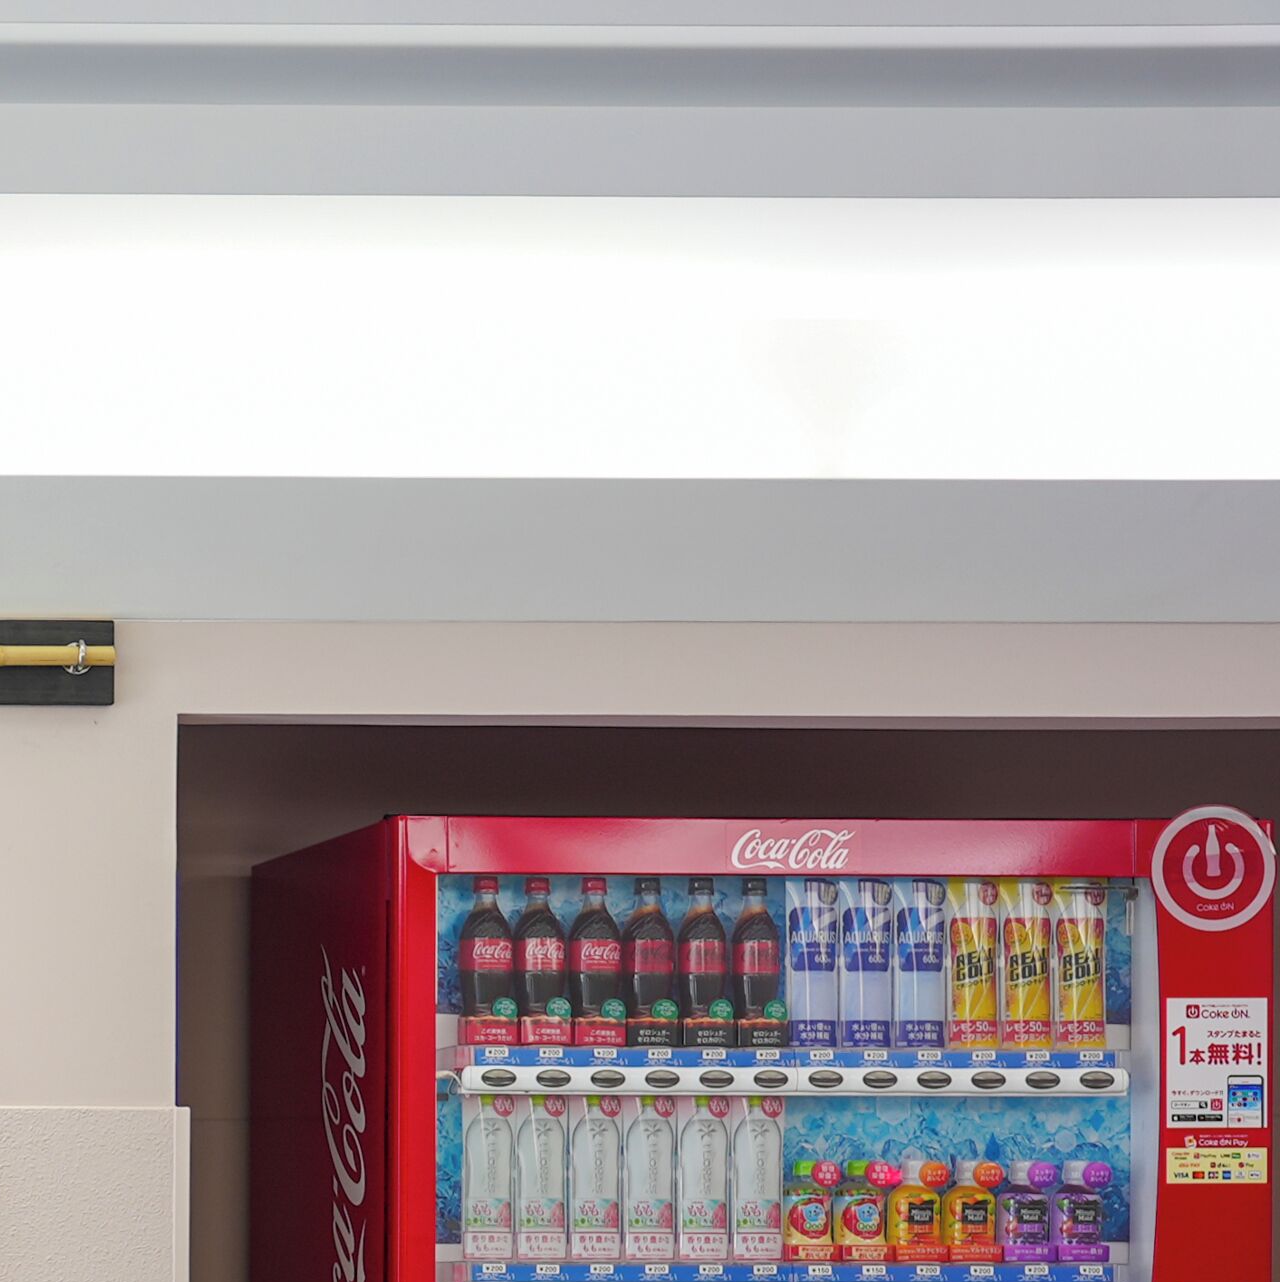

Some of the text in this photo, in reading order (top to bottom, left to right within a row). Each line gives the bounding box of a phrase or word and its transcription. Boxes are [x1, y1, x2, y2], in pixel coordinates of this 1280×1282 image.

[791, 930, 836, 944] AQUARIUS
[845, 930, 889, 944] AQUARIUS
[899, 930, 943, 944] AQUARIUS
[1201, 1009, 1229, 1019] Coke
[1207, 1030, 1261, 1038] スタンプたまると
